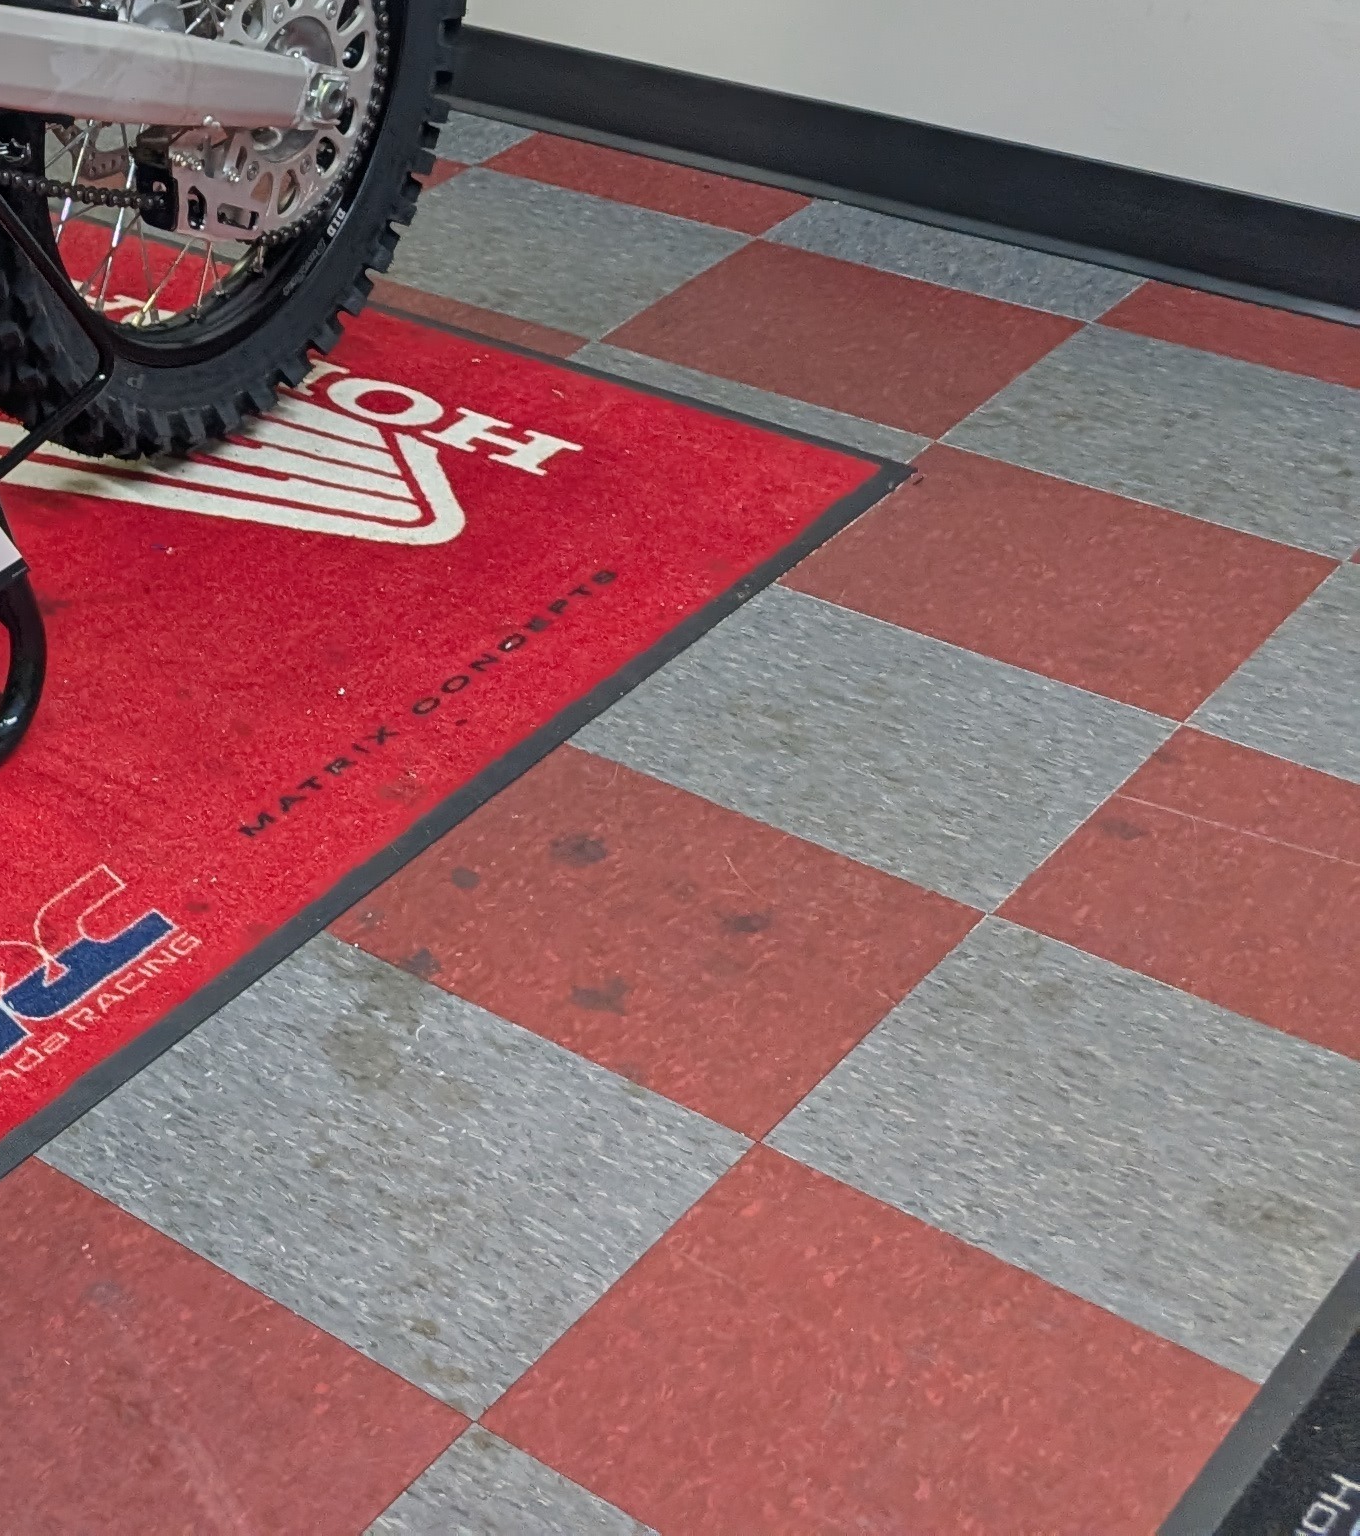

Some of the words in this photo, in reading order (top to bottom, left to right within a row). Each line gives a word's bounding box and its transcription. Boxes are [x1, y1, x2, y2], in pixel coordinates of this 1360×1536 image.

[239, 726, 400, 837] MATRIX
[411, 570, 618, 715] CONCEPTS
[66, 933, 202, 1030] RACING
